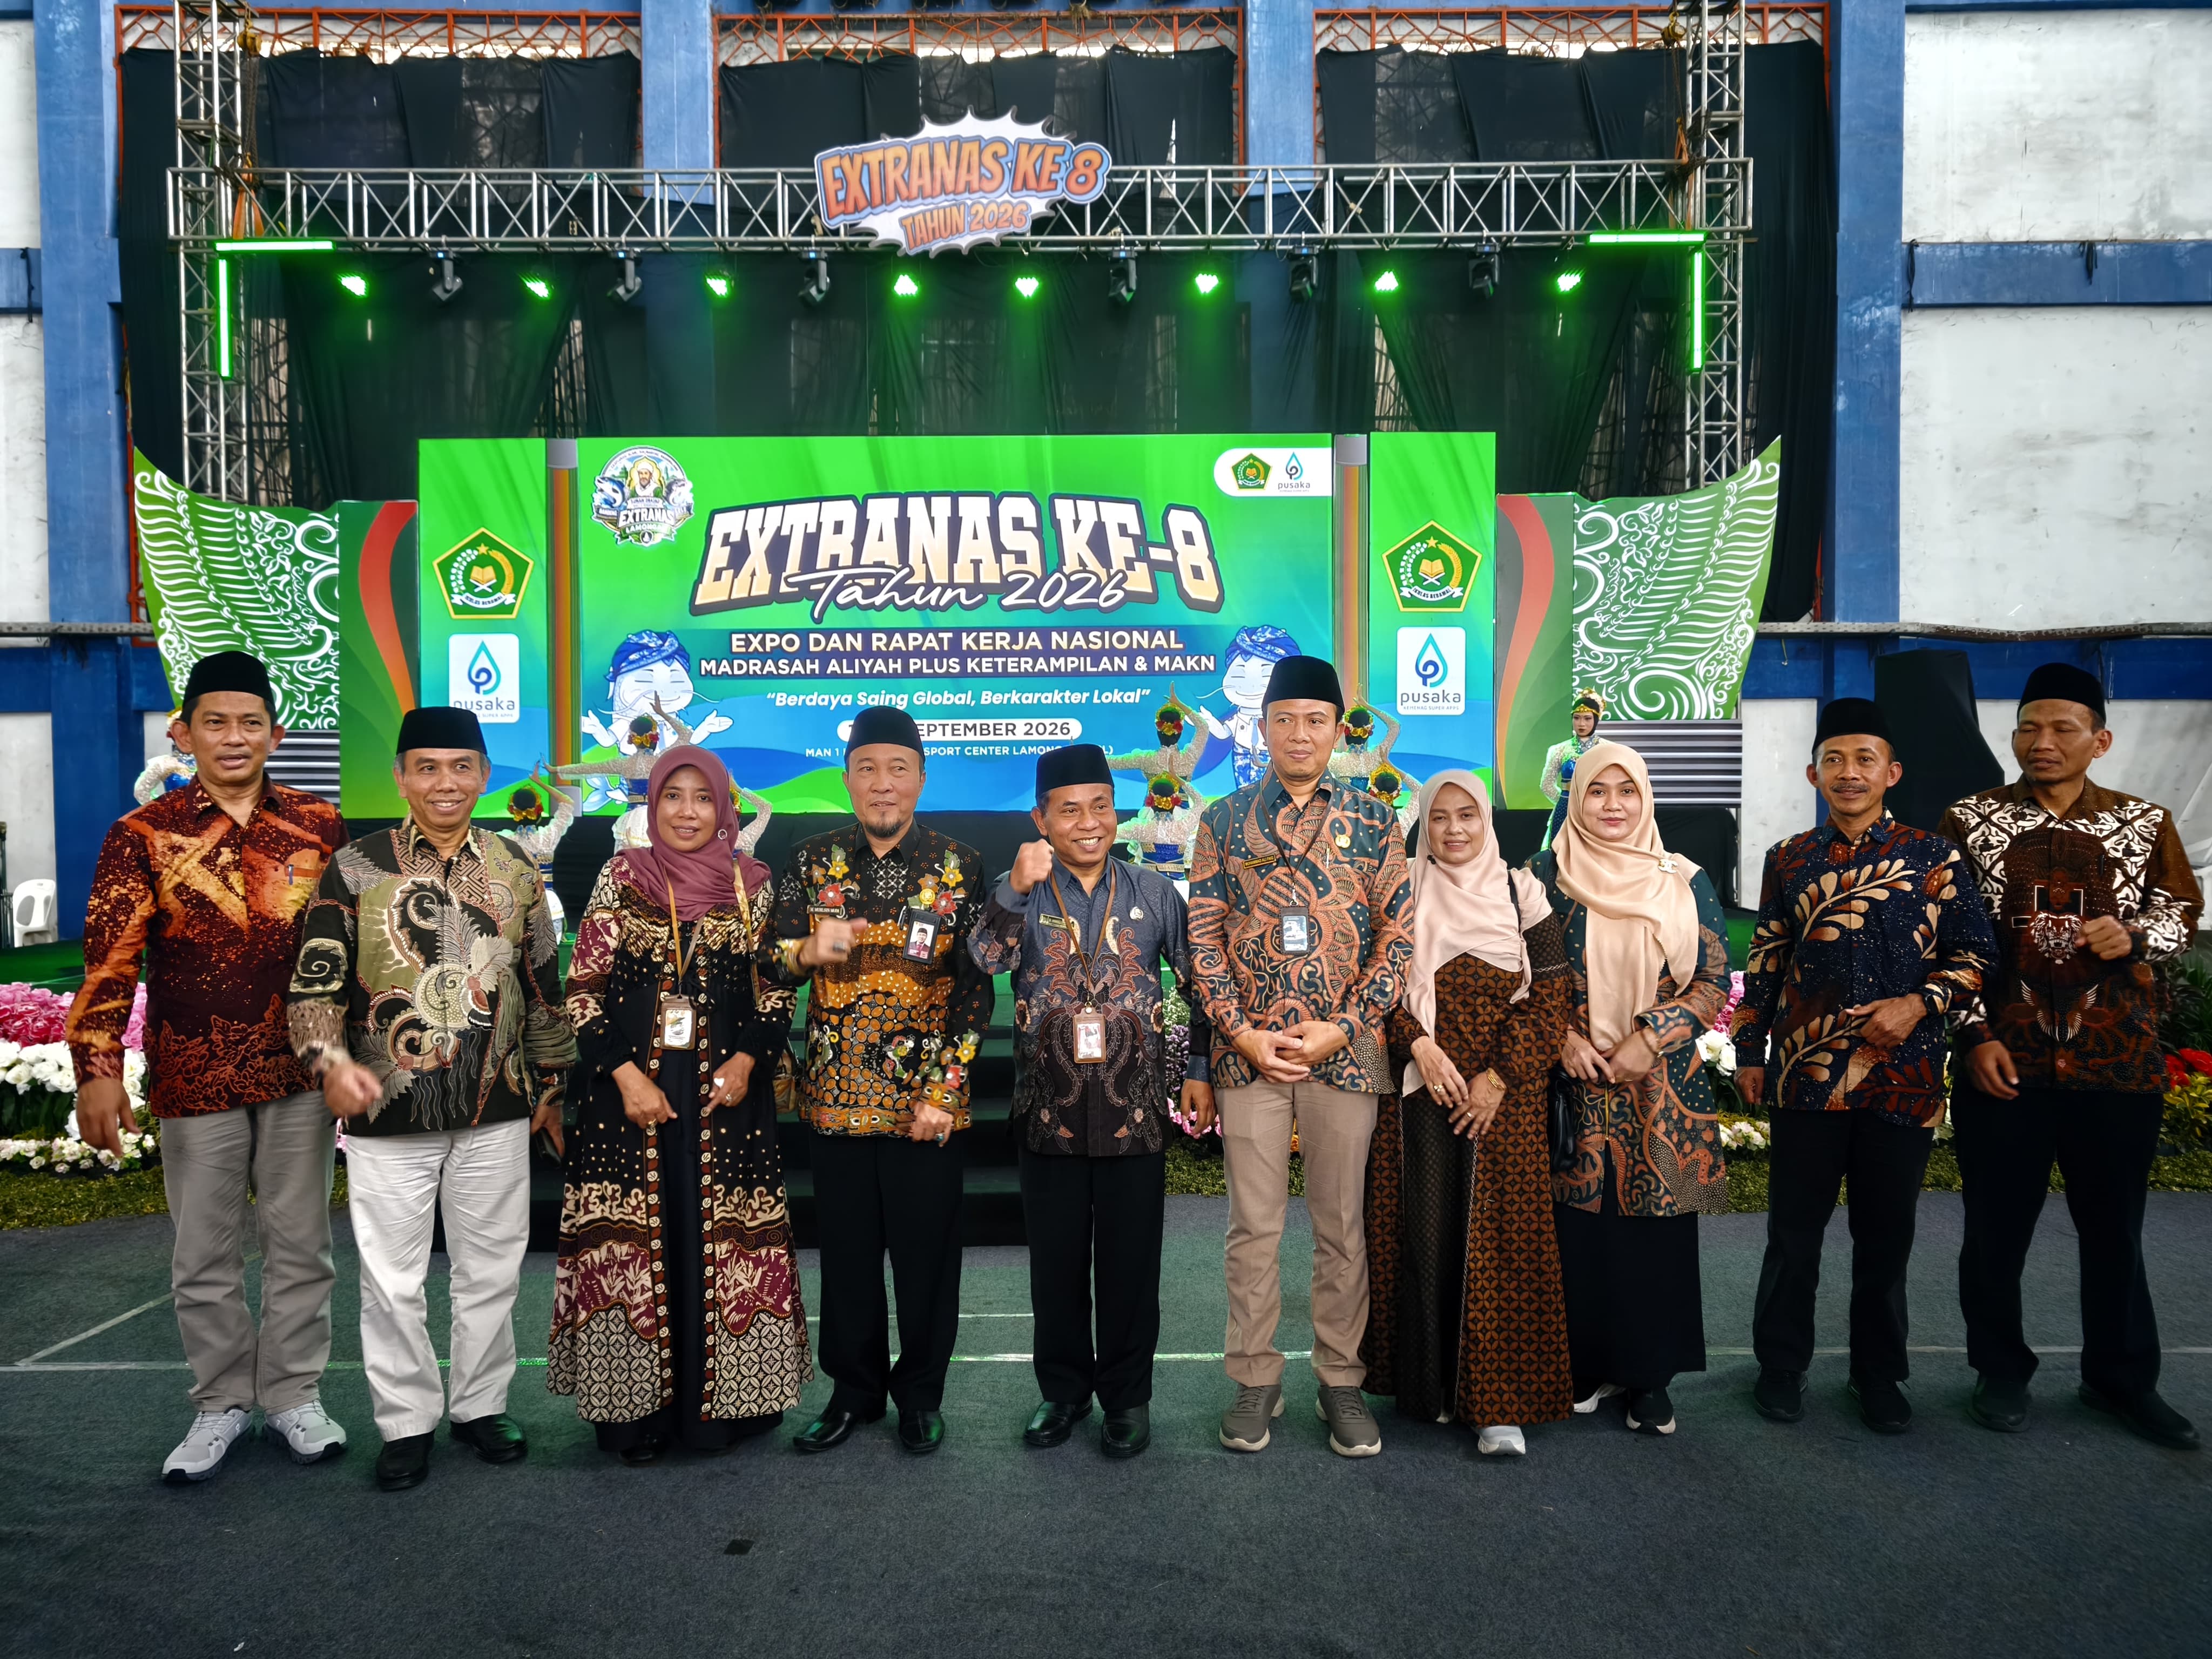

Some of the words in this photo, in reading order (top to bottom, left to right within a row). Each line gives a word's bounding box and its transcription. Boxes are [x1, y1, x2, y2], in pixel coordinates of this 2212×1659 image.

[820, 140, 1009, 220] EXTRANAS
[1011, 143, 1067, 192] KE
[1064, 149, 1103, 196] 8
[901, 204, 966, 251] TAHUN
[969, 202, 1028, 232] 2026
[1278, 481, 1311, 490] pusaka
[619, 508, 675, 524] EXTRANAS
[625, 523, 666, 534] LAMONGA
[694, 495, 1043, 606] EXTRANAS
[1054, 497, 1220, 603] KE-8
[784, 567, 983, 619] Tahun
[1001, 570, 1127, 609] 2026
[731, 632, 800, 652] EXPO
[809, 632, 862, 652] DAN
[871, 631, 953, 651] RAPAT
[961, 631, 1043, 650] KERJA
[1051, 630, 1184, 650] NASIONAL
[700, 658, 820, 675] MADRASAH
[826, 658, 902, 675] ALIYAH
[909, 657, 961, 673] PLUS
[967, 656, 1128, 673] KETERAMPILAN
[1134, 655, 1148, 672] &
[1154, 655, 1215, 671] MAKN
[766, 692, 853, 710] “Berdaya
[856, 690, 908, 710] Saing
[913, 690, 976, 707] Global,
[980, 689, 1090, 705] Berkarakter
[1092, 688, 1151, 704] Lokal”
[1400, 689, 1461, 706] pusaka
[916, 723, 1017, 736] EPTEMBER
[1023, 721, 1071, 736] 2026
[806, 748, 831, 757] MAN
[834, 748, 839, 757] 1
[964, 746, 1009, 756] CENTER
